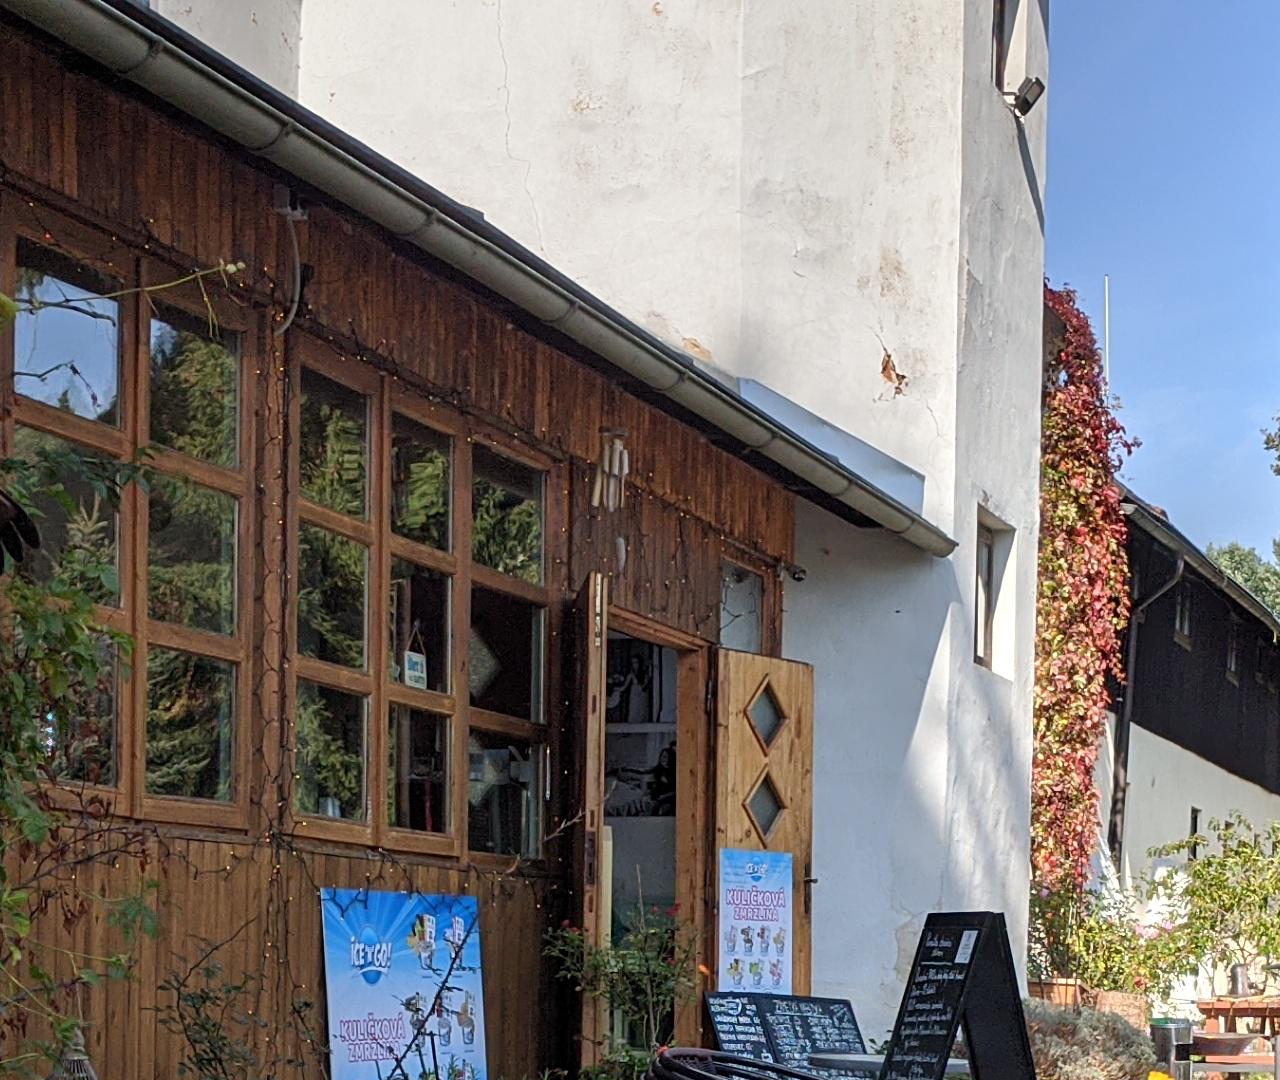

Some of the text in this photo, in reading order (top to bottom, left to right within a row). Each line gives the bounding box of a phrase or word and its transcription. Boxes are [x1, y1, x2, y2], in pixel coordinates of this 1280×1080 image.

[726, 885, 786, 908] KULIČKOVÁ
[734, 907, 780, 921] ZMRZLINA
[339, 1012, 407, 1042] KULIČKOVÁ
